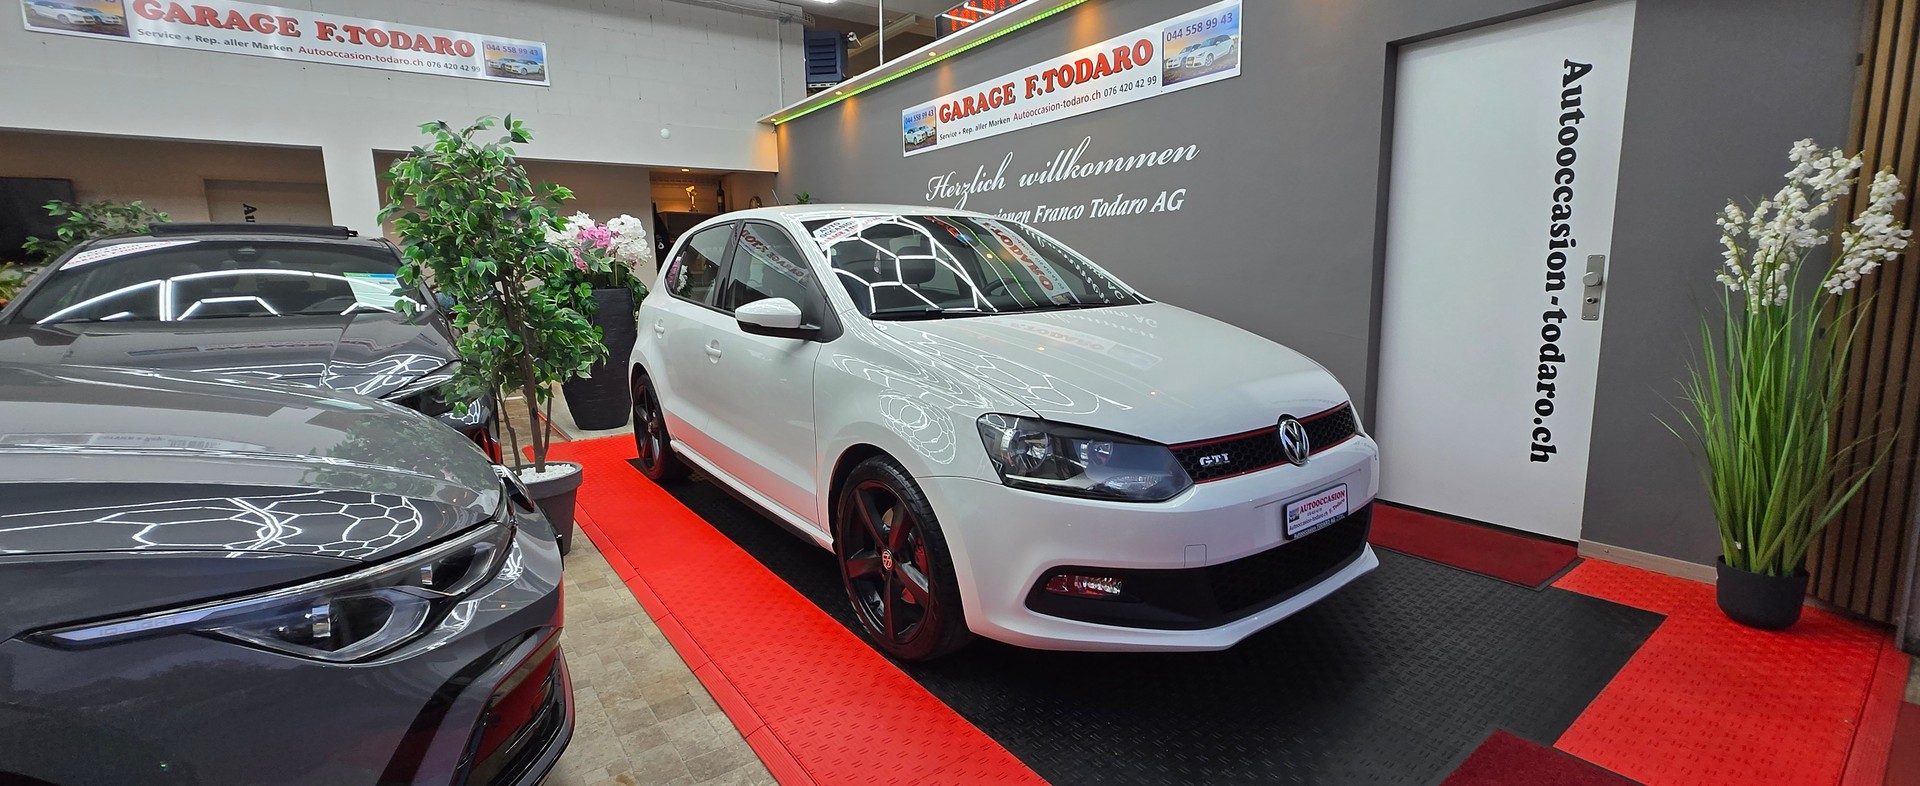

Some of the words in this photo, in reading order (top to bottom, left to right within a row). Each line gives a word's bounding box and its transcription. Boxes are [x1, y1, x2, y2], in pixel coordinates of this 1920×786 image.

[132, 0, 302, 38] GARAGE
[314, 20, 476, 58] F.TODARO
[486, 43, 500, 51] 044
[502, 46, 517, 54] 558
[518, 47, 528, 55] 99
[1166, 28, 1183, 42] 044
[1185, 22, 1203, 36] 558
[1205, 17, 1218, 30] 99
[1220, 12, 1233, 25] 43
[137, 28, 182, 40] Service
[195, 35, 220, 46] Rep.
[223, 39, 249, 48] aller
[252, 41, 293, 53] Marken
[298, 45, 424, 67] Autooccasion-todaro.ch
[426, 61, 442, 69] 076
[443, 62, 458, 71] 420
[459, 64, 471, 72] 42
[471, 65, 481, 73] 99
[939, 82, 1017, 124] GARAGE
[1024, 38, 1154, 100] F.TODARO
[939, 131, 958, 141] Service
[962, 127, 973, 137] Rep.
[975, 123, 987, 132] aller
[988, 117, 1011, 128] Marken
[1013, 88, 1102, 122] Autooccasion-todaro.ch
[1103, 86, 1118, 98] 076
[1119, 82, 1133, 94] 420
[1135, 78, 1145, 89] 42
[1147, 75, 1157, 86] 99
[925, 151, 1014, 211] Herzlich
[1019, 135, 1200, 188] willkommen
[1033, 203, 1085, 224] Franco
[1088, 193, 1148, 219] Todaro
[1149, 188, 1187, 213] AG
[1529, 57, 1593, 464] Autooccasion-todaro.ch
[1199, 453, 1230, 467] GTI
[1300, 489, 1346, 513] AUTOOCCASION
